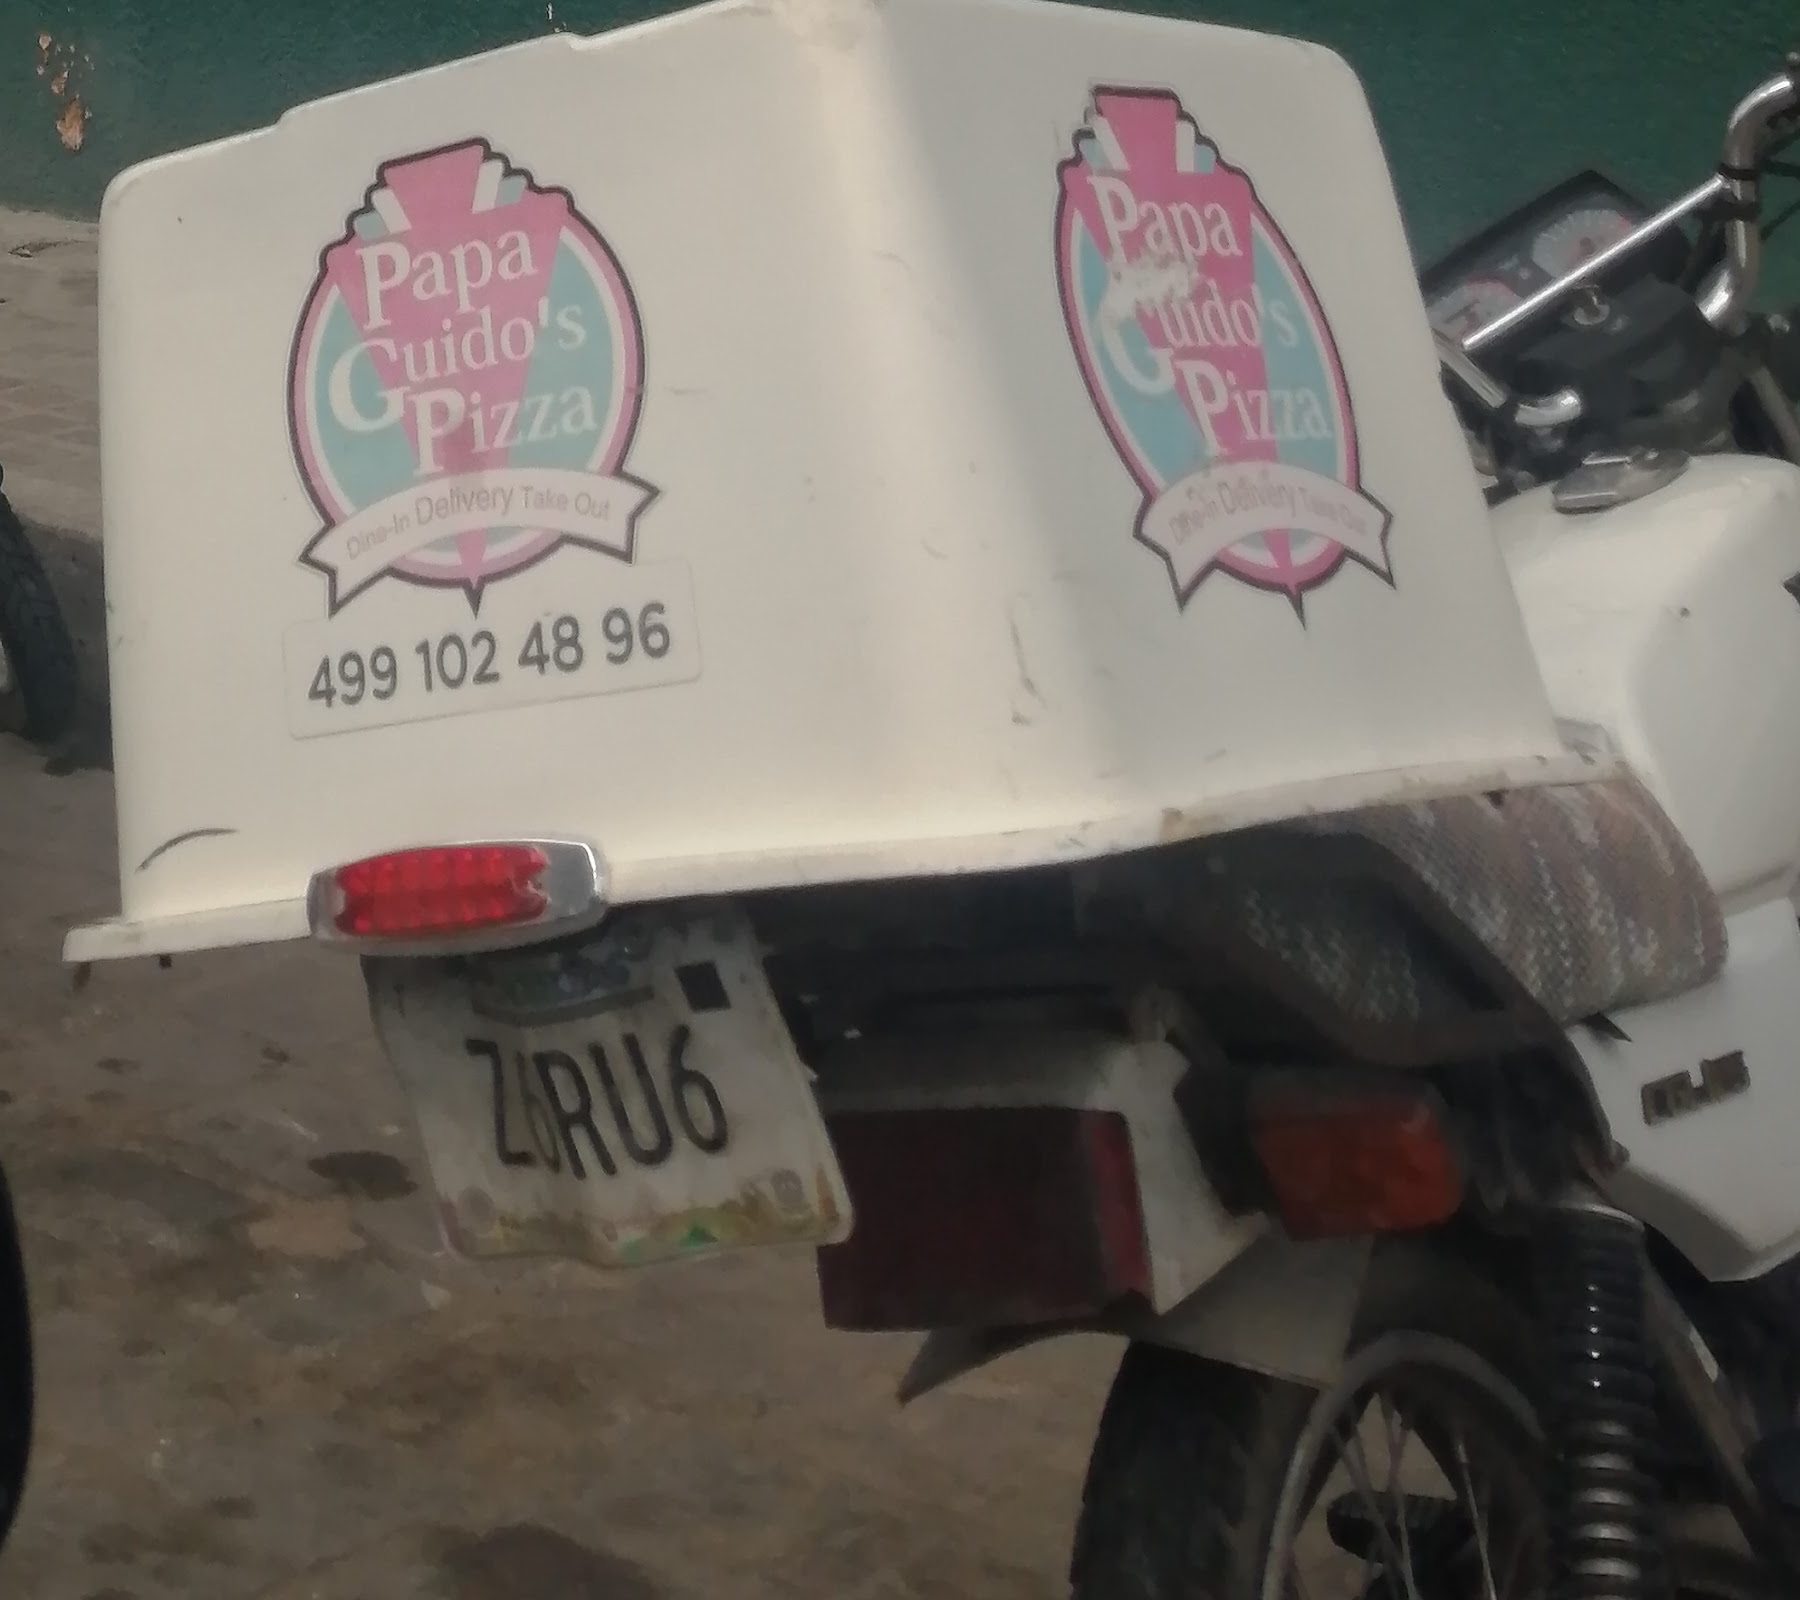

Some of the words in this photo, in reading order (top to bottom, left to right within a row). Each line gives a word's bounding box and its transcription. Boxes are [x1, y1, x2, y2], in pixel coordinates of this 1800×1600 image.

[1087, 174, 1243, 276] Papa
[356, 228, 538, 332] Papa
[328, 297, 587, 434] Guido's
[1174, 359, 1334, 457] Pizza
[403, 382, 598, 478] Pizza
[415, 484, 514, 526] Delivery
[574, 490, 611, 521] Out
[308, 646, 398, 709] 499
[415, 628, 502, 693] 102
[517, 613, 585, 677] 48
[600, 600, 673, 663] 96
